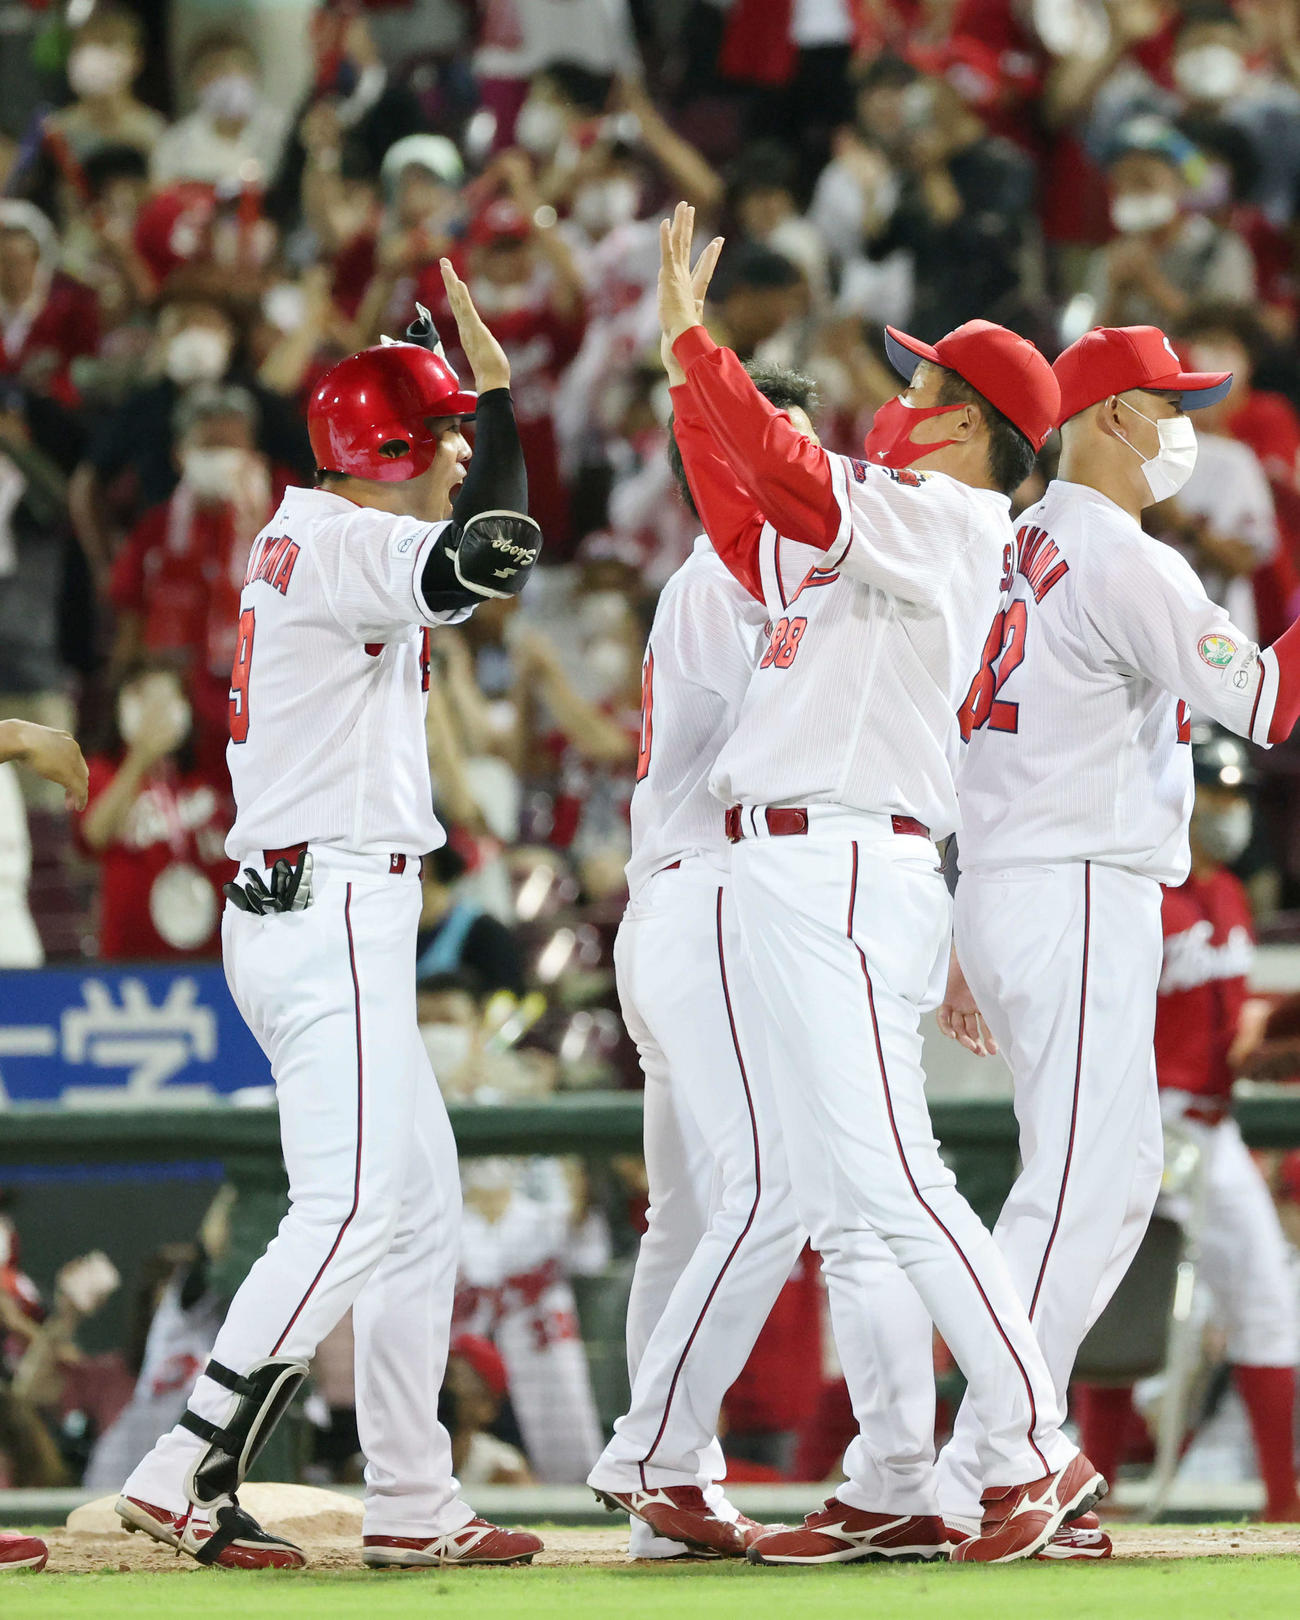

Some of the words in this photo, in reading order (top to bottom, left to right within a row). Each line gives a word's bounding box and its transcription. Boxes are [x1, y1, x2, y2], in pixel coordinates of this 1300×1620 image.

[490, 539, 536, 566] Shogo
[760, 615, 808, 669] 88
[228, 605, 256, 744] 9
